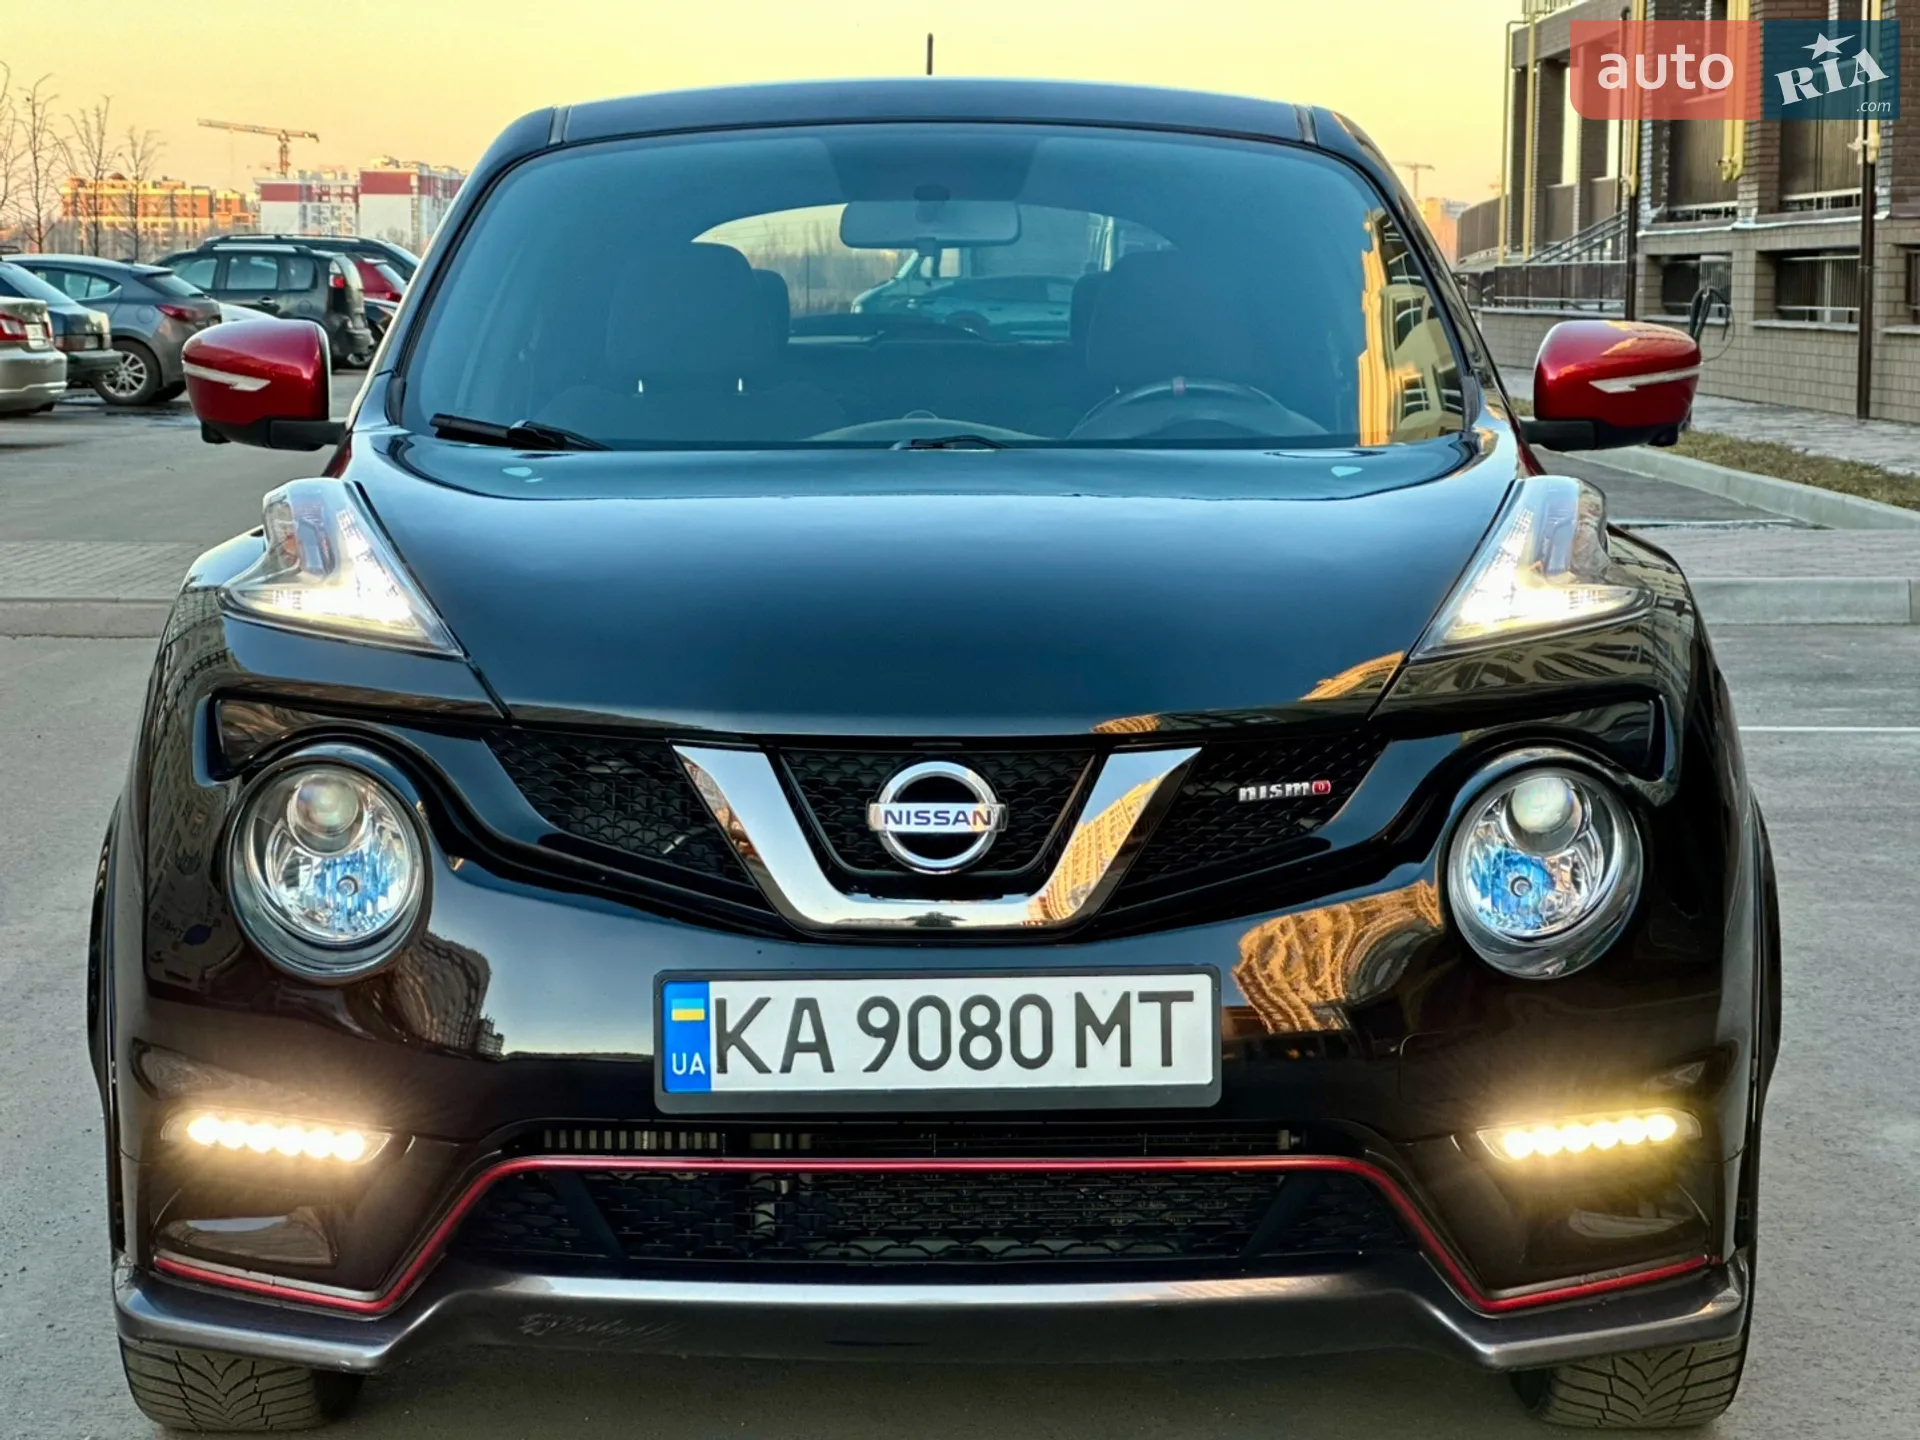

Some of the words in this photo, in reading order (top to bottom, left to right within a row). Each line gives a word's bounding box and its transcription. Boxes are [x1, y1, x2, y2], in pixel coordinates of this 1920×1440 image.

[1238, 780, 1332, 802] nismo
[883, 809, 992, 826] NISSAN
[715, 996, 835, 1075] KA
[856, 993, 1054, 1074] 9080
[1074, 990, 1195, 1068] MT
[671, 1052, 706, 1076] UA
